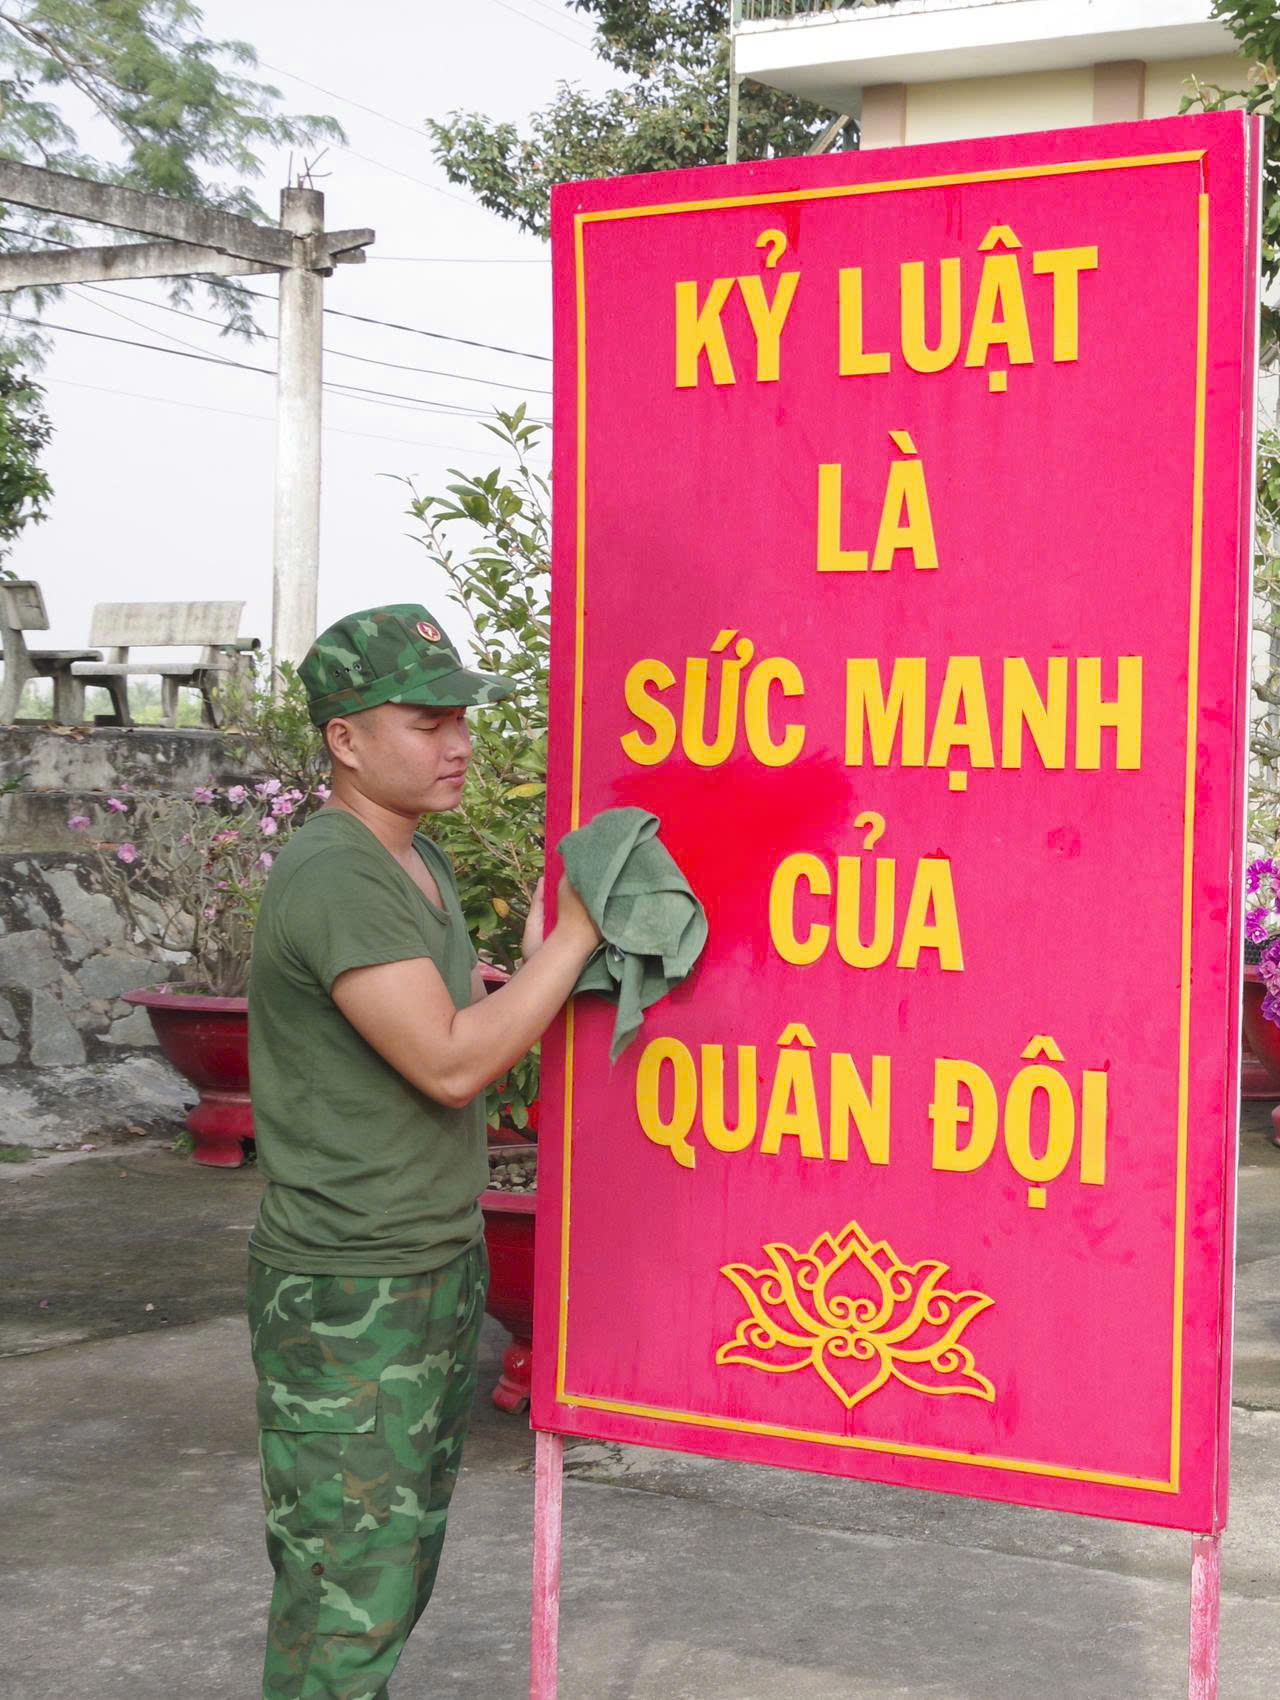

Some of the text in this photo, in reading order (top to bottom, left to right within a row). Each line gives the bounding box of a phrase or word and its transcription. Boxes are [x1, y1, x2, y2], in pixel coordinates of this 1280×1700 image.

[676, 225, 1098, 392] KỶ LUẬT
[817, 431, 938, 571] LÀ
[620, 630, 1142, 790] SỨC MẠNH
[770, 811, 964, 971] CỦA
[637, 1023, 1107, 1208] QUÂN ĐỘI
